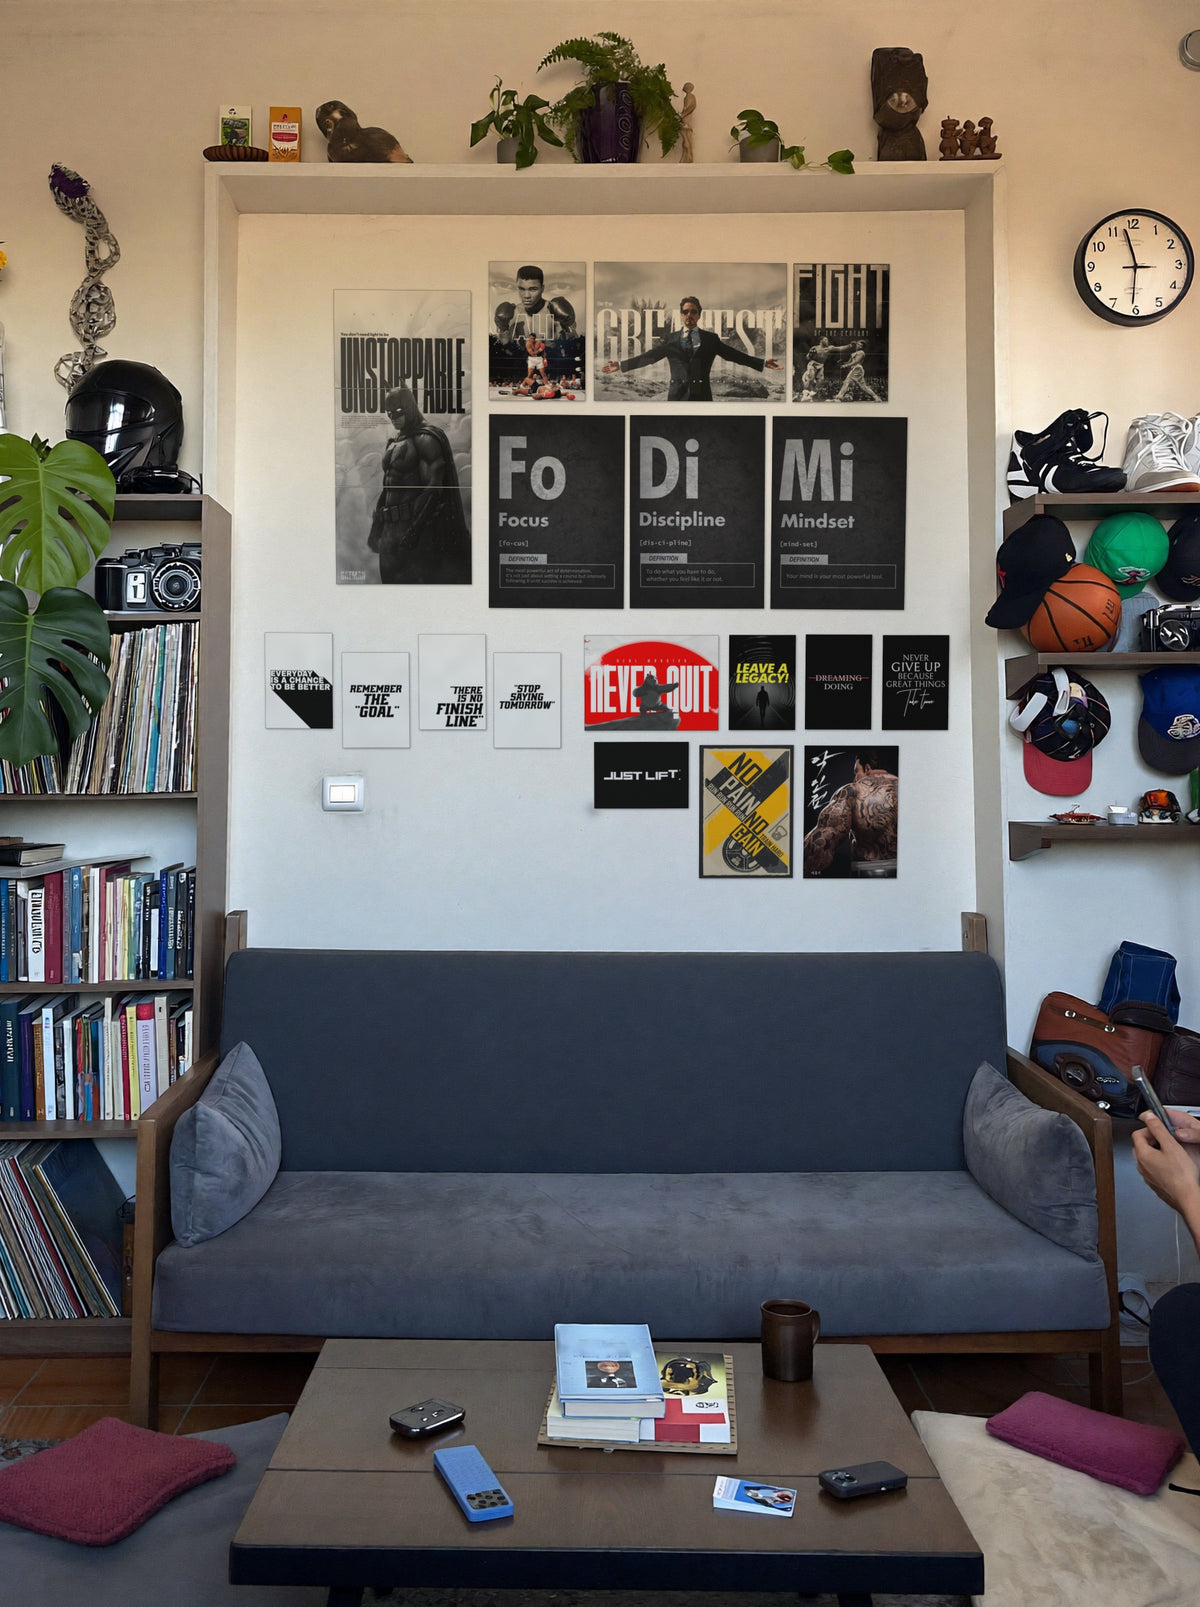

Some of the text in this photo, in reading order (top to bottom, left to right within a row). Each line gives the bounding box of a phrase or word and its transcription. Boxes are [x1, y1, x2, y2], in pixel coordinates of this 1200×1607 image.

[1127, 218, 1140, 230] 12
[1153, 224, 1158, 236] 1
[1108, 226, 1118, 237] 11
[1092, 241, 1106, 252] 10
[1166, 238, 1176, 250] 2
[1087, 261, 1096, 272] 9
[1174, 259, 1183, 270] 3
[1093, 282, 1102, 292] 8
[1169, 280, 1177, 290] 4
[793, 264, 889, 329] FIGHT
[1108, 297, 1118, 308] 7
[1155, 296, 1163, 308] 5
[1132, 305, 1140, 315] 6
[512, 313, 555, 341] ALI
[597, 308, 783, 366] GREEST
[340, 337, 466, 414] UNSTOPPABLE
[499, 435, 566, 500] Fo
[640, 435, 699, 499] Di
[779, 438, 854, 501] Mi
[498, 512, 550, 527] Focus
[639, 510, 726, 531] Discipline
[781, 512, 855, 528] Mindset
[736, 663, 788, 674] LEAVE A
[891, 661, 941, 672] GIVE UP
[735, 673, 789, 684] LEGACY!
[815, 674, 862, 682] DREAMING
[898, 672, 934, 680] BECAUSE
[350, 684, 402, 693] REMEMBER
[885, 680, 946, 688] GREAT THINGS
[510, 693, 544, 701] SAYING
[666, 665, 713, 719] QUIT
[364, 693, 390, 705] THE
[457, 694, 483, 703] IS NO
[436, 703, 484, 715] FINISH
[728, 752, 763, 786] NO
[603, 771, 643, 781] JUST
[719, 775, 761, 816] PAIN
[744, 811, 769, 836] NO
[730, 824, 765, 857] GAIN
[759, 833, 784, 857] TRAIN HARD
